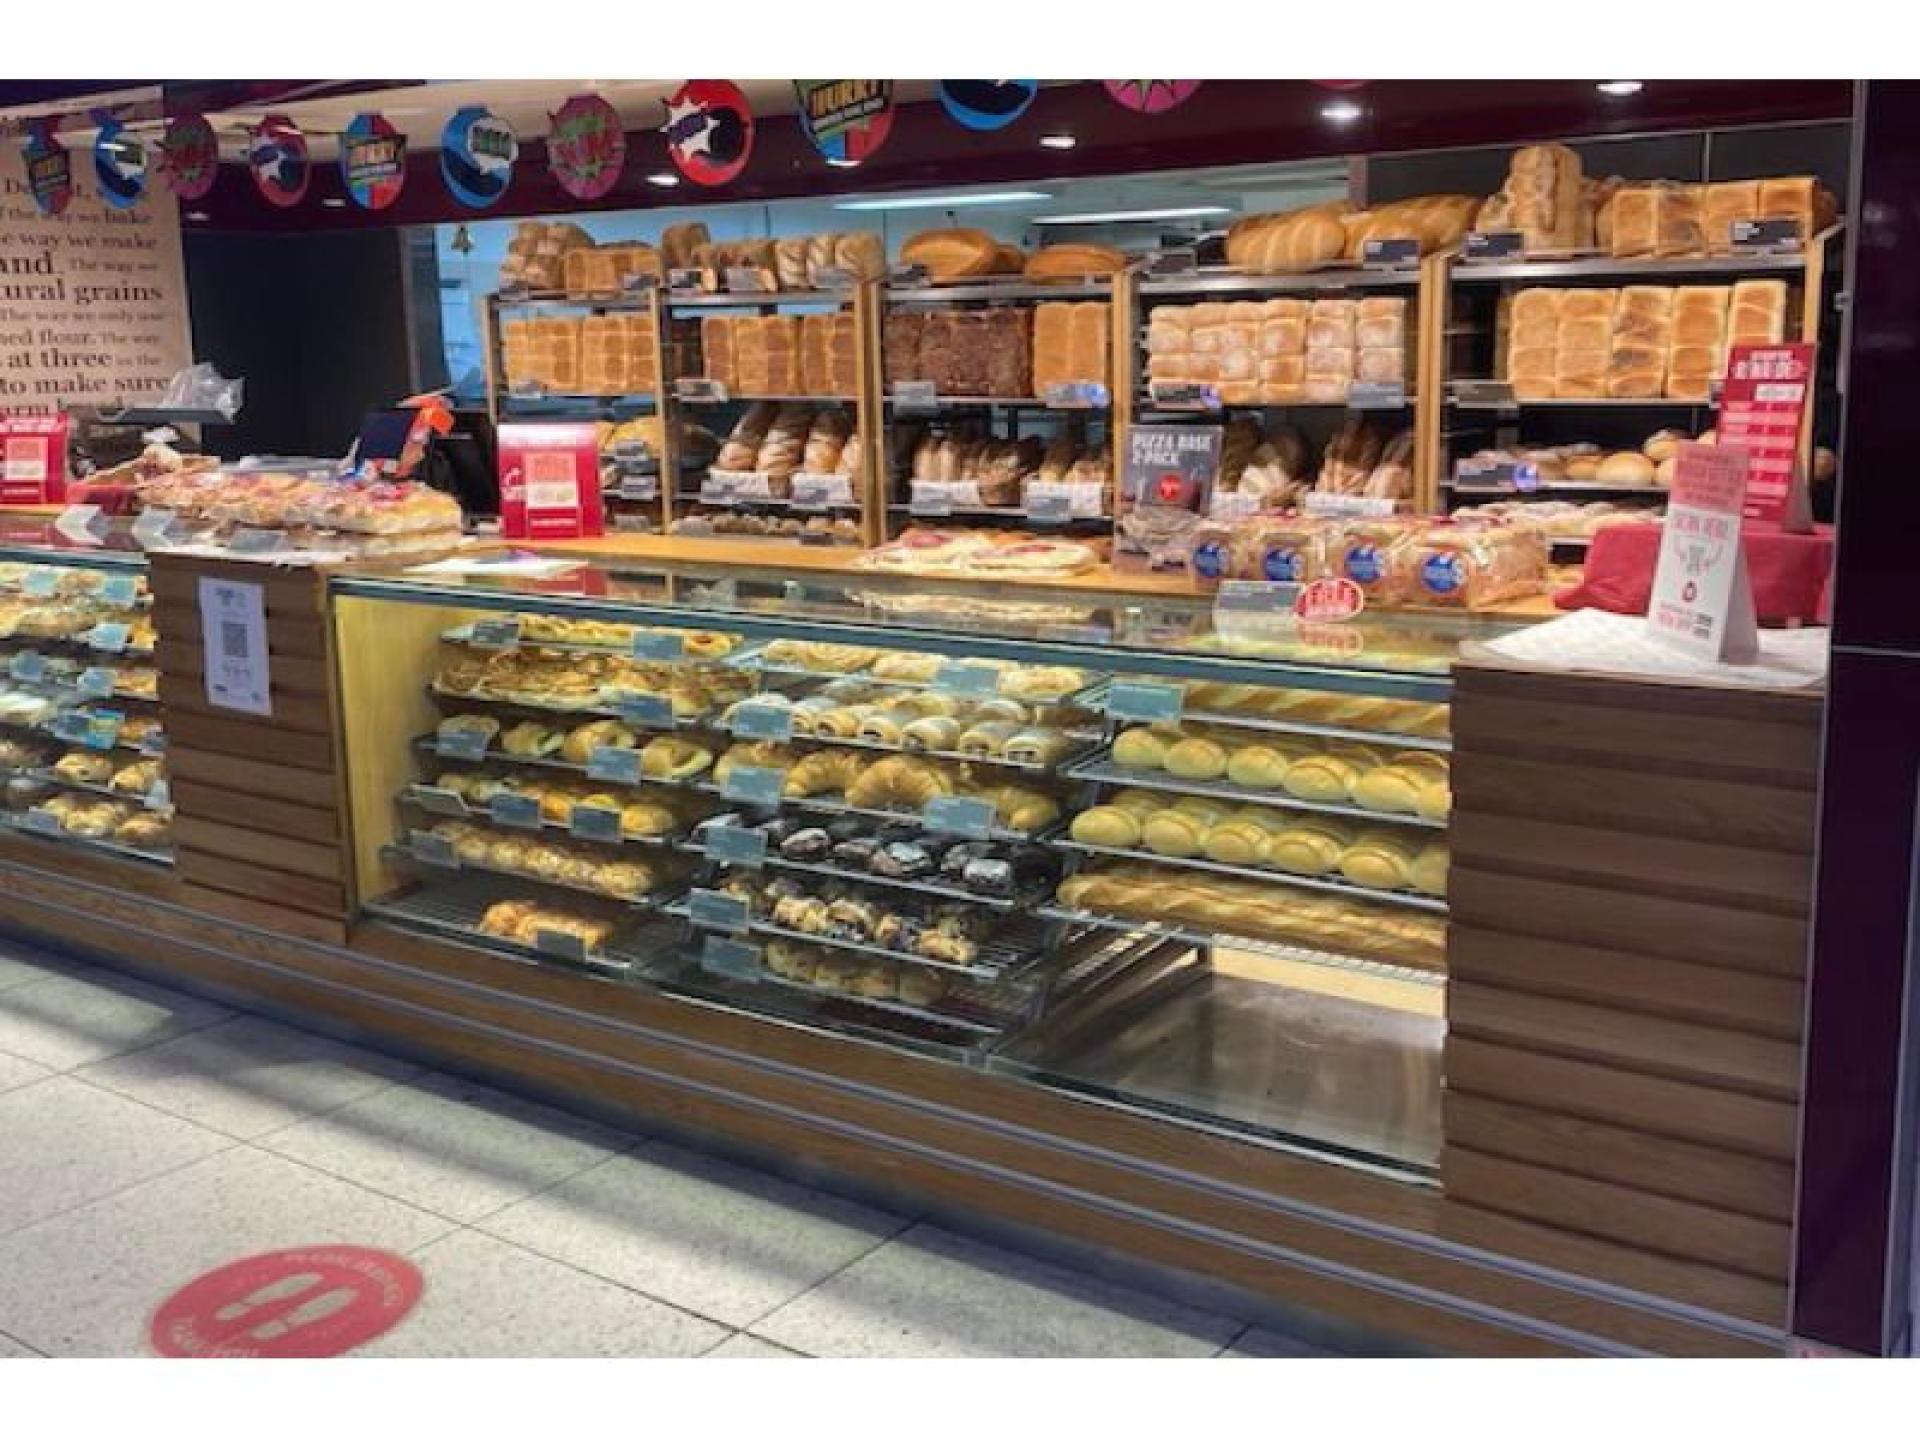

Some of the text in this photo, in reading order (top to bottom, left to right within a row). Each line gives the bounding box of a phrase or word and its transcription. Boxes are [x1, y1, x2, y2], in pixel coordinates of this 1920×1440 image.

[20, 234, 60, 250] way
[67, 233, 96, 246] we
[103, 233, 157, 248] make
[73, 279, 163, 305] grains
[8, 352, 32, 368] at
[40, 347, 114, 368] three
[35, 371, 107, 394] make
[114, 376, 172, 394] sure
[1132, 431, 1212, 452] PIZZA BASE
